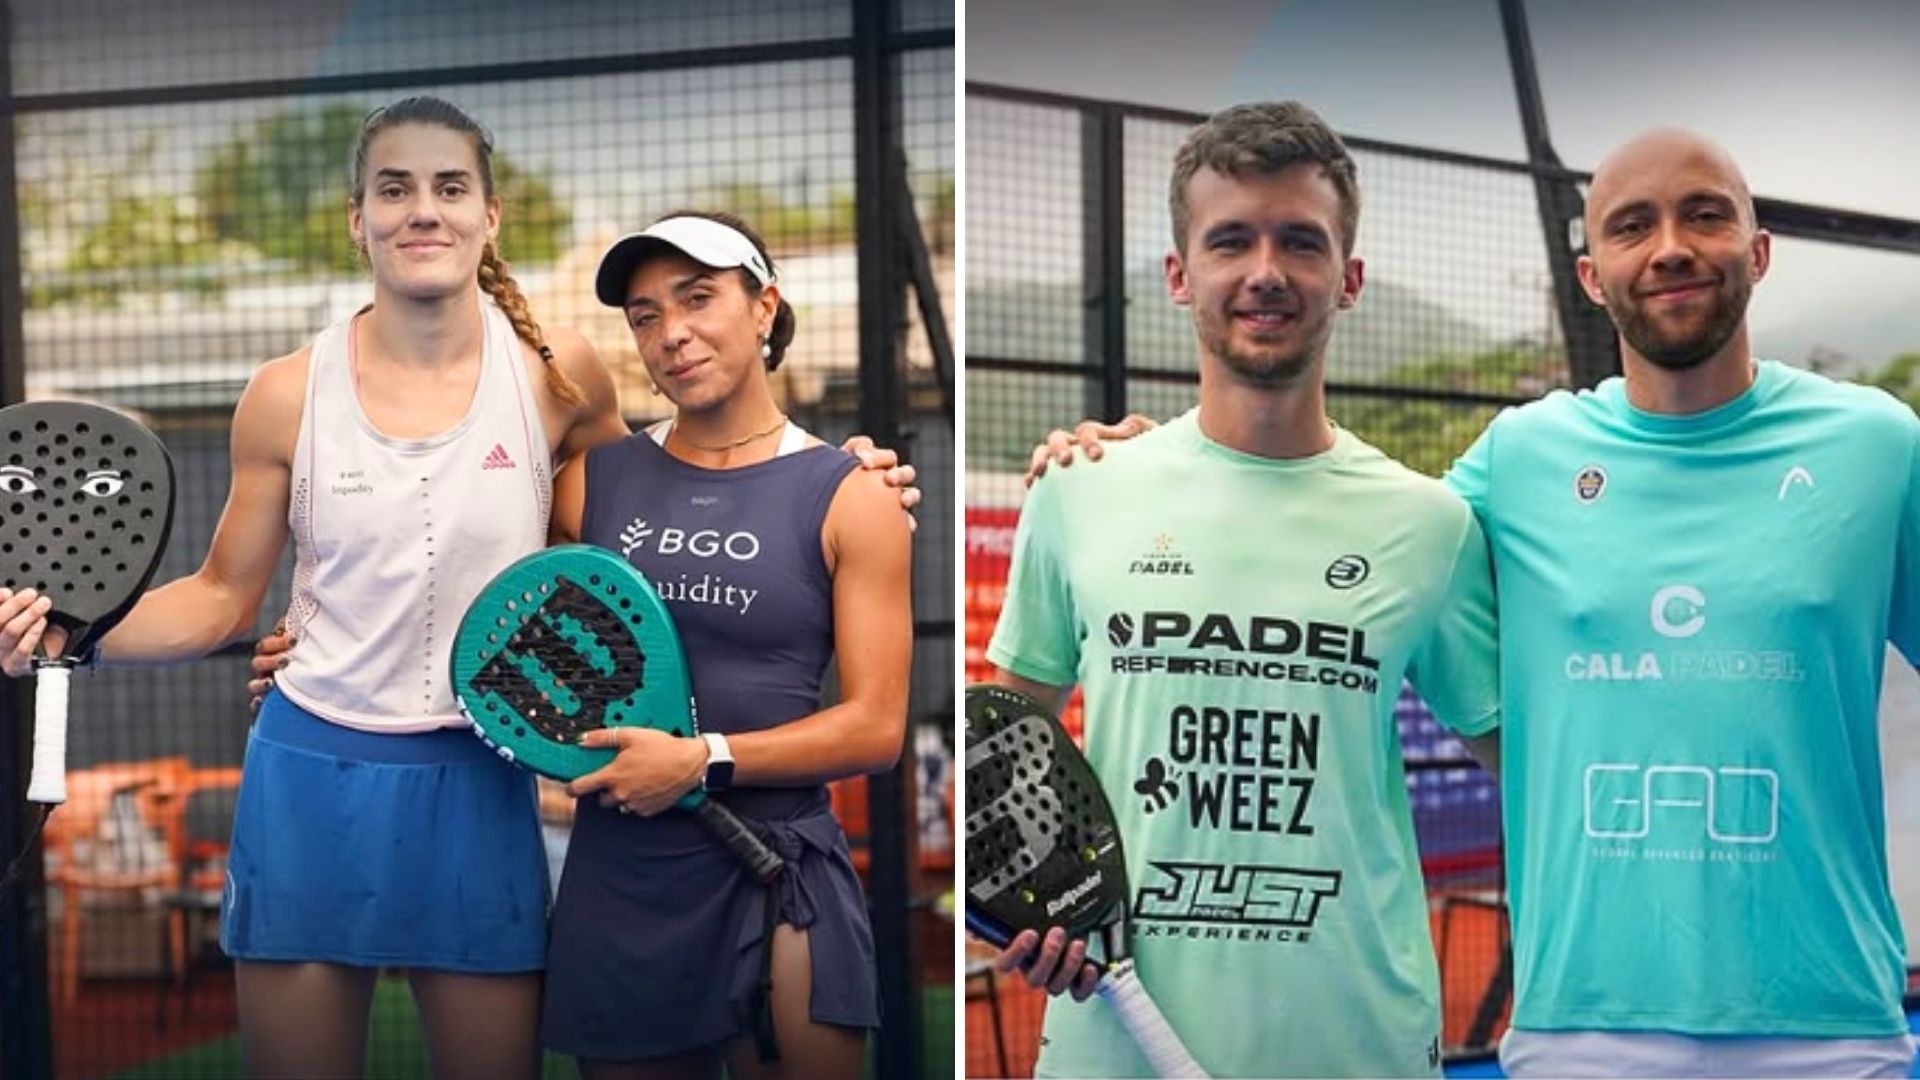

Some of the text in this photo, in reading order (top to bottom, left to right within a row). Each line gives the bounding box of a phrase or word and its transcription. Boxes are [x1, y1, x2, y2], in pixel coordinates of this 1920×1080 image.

[658, 528, 760, 561] BGO
[1128, 560, 1195, 575] PADEL
[657, 574, 758, 615] uidity
[1142, 611, 1380, 671] PADEL
[1564, 651, 1806, 683] CALA PADEL
[1169, 704, 1320, 770] GREEN
[1187, 771, 1315, 835] WEEZ
[1133, 861, 1342, 927] JUST
